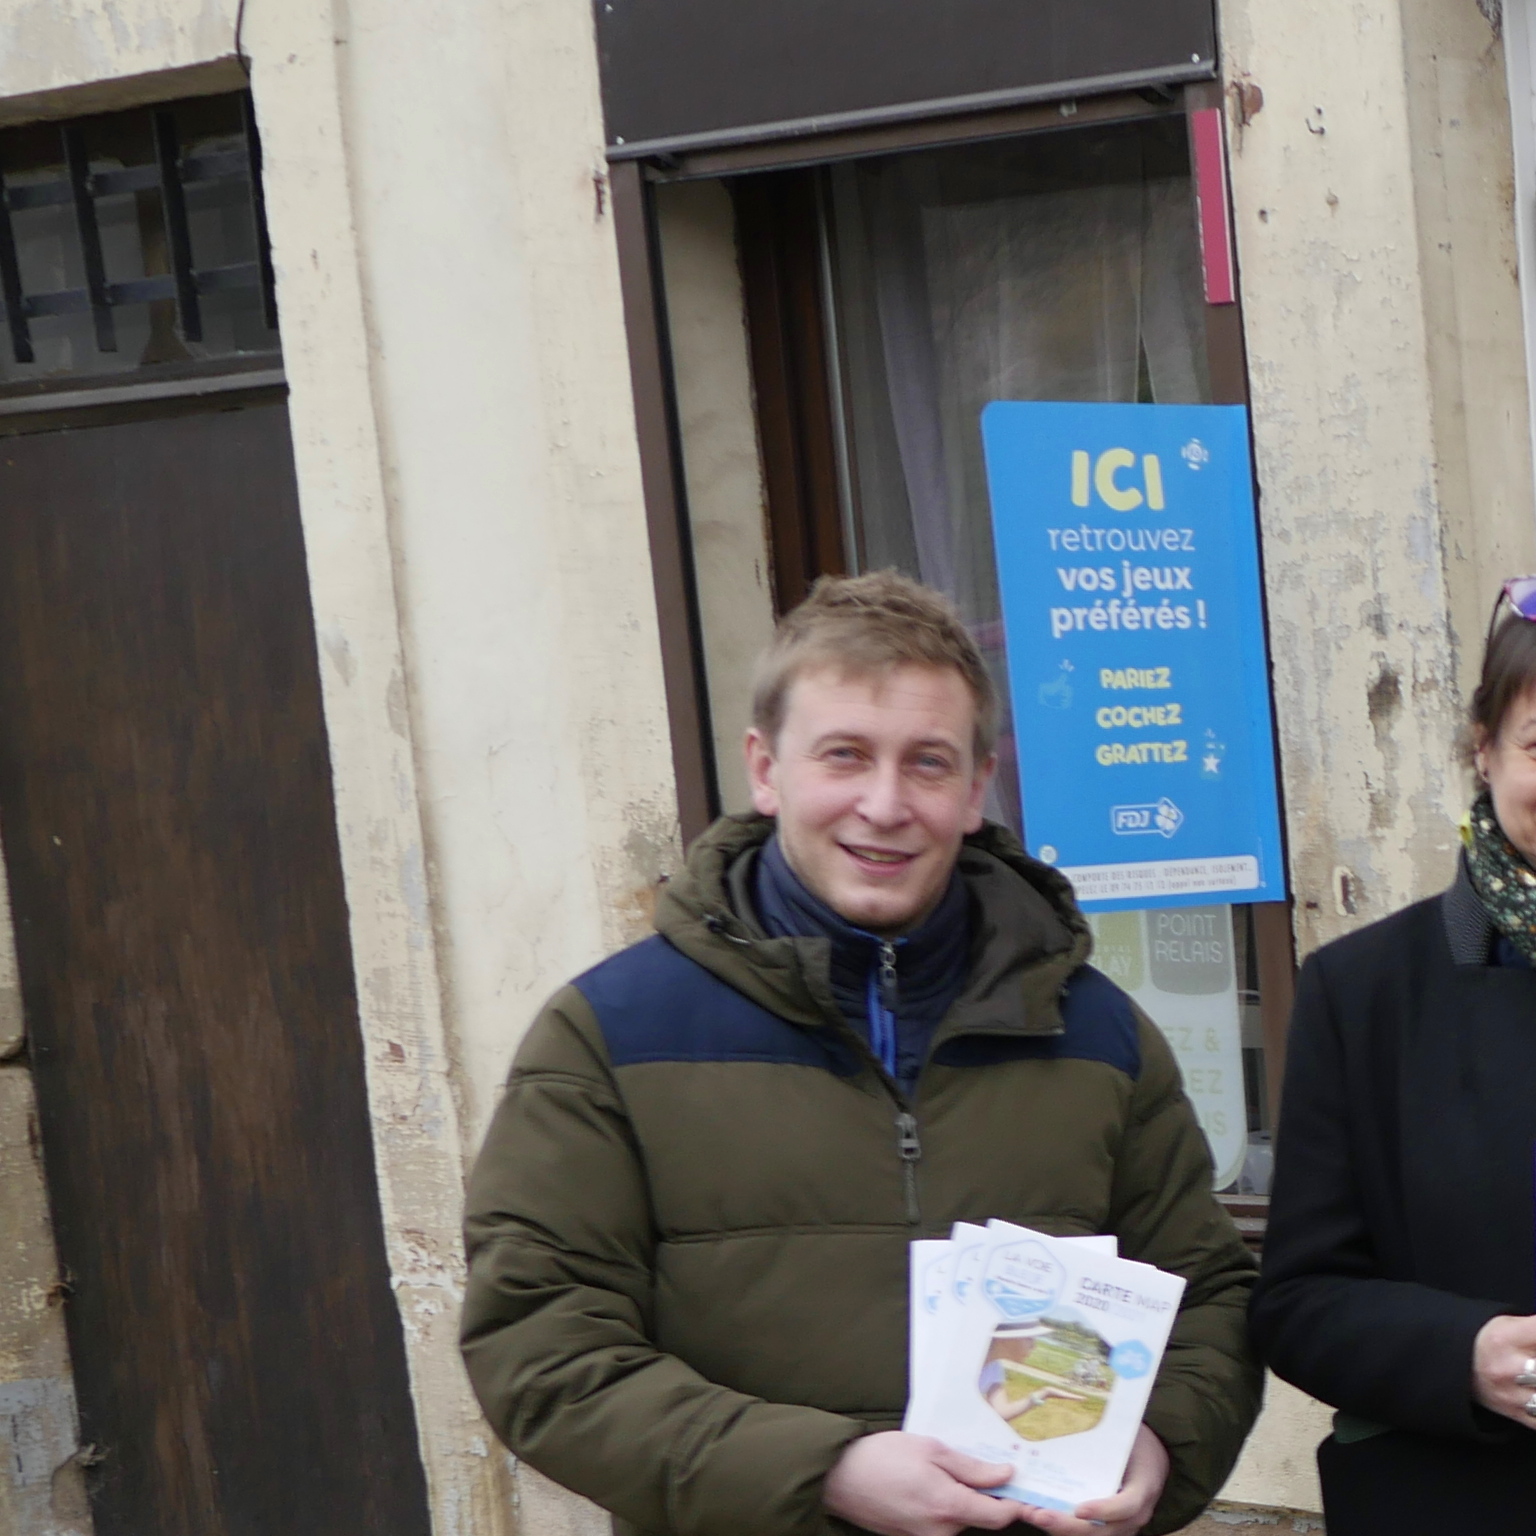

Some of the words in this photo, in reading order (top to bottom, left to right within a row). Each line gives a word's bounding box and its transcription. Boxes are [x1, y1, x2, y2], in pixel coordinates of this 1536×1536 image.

[1071, 448, 1166, 511] ICI
[1046, 524, 1195, 552] retrouvez
[1057, 566, 1116, 590] vos
[1121, 561, 1193, 599] jeux
[1051, 599, 1192, 638] préférés
[1198, 599, 1208, 630] !
[1100, 667, 1172, 690] PARIEZ
[1096, 704, 1182, 728] COCHEZ
[1096, 740, 1187, 766] GRATTEZ
[1116, 808, 1151, 829] FDJ
[1157, 913, 1217, 936] POINT
[1154, 939, 1223, 963] RELAIS
[1081, 1276, 1132, 1303] CARTE
